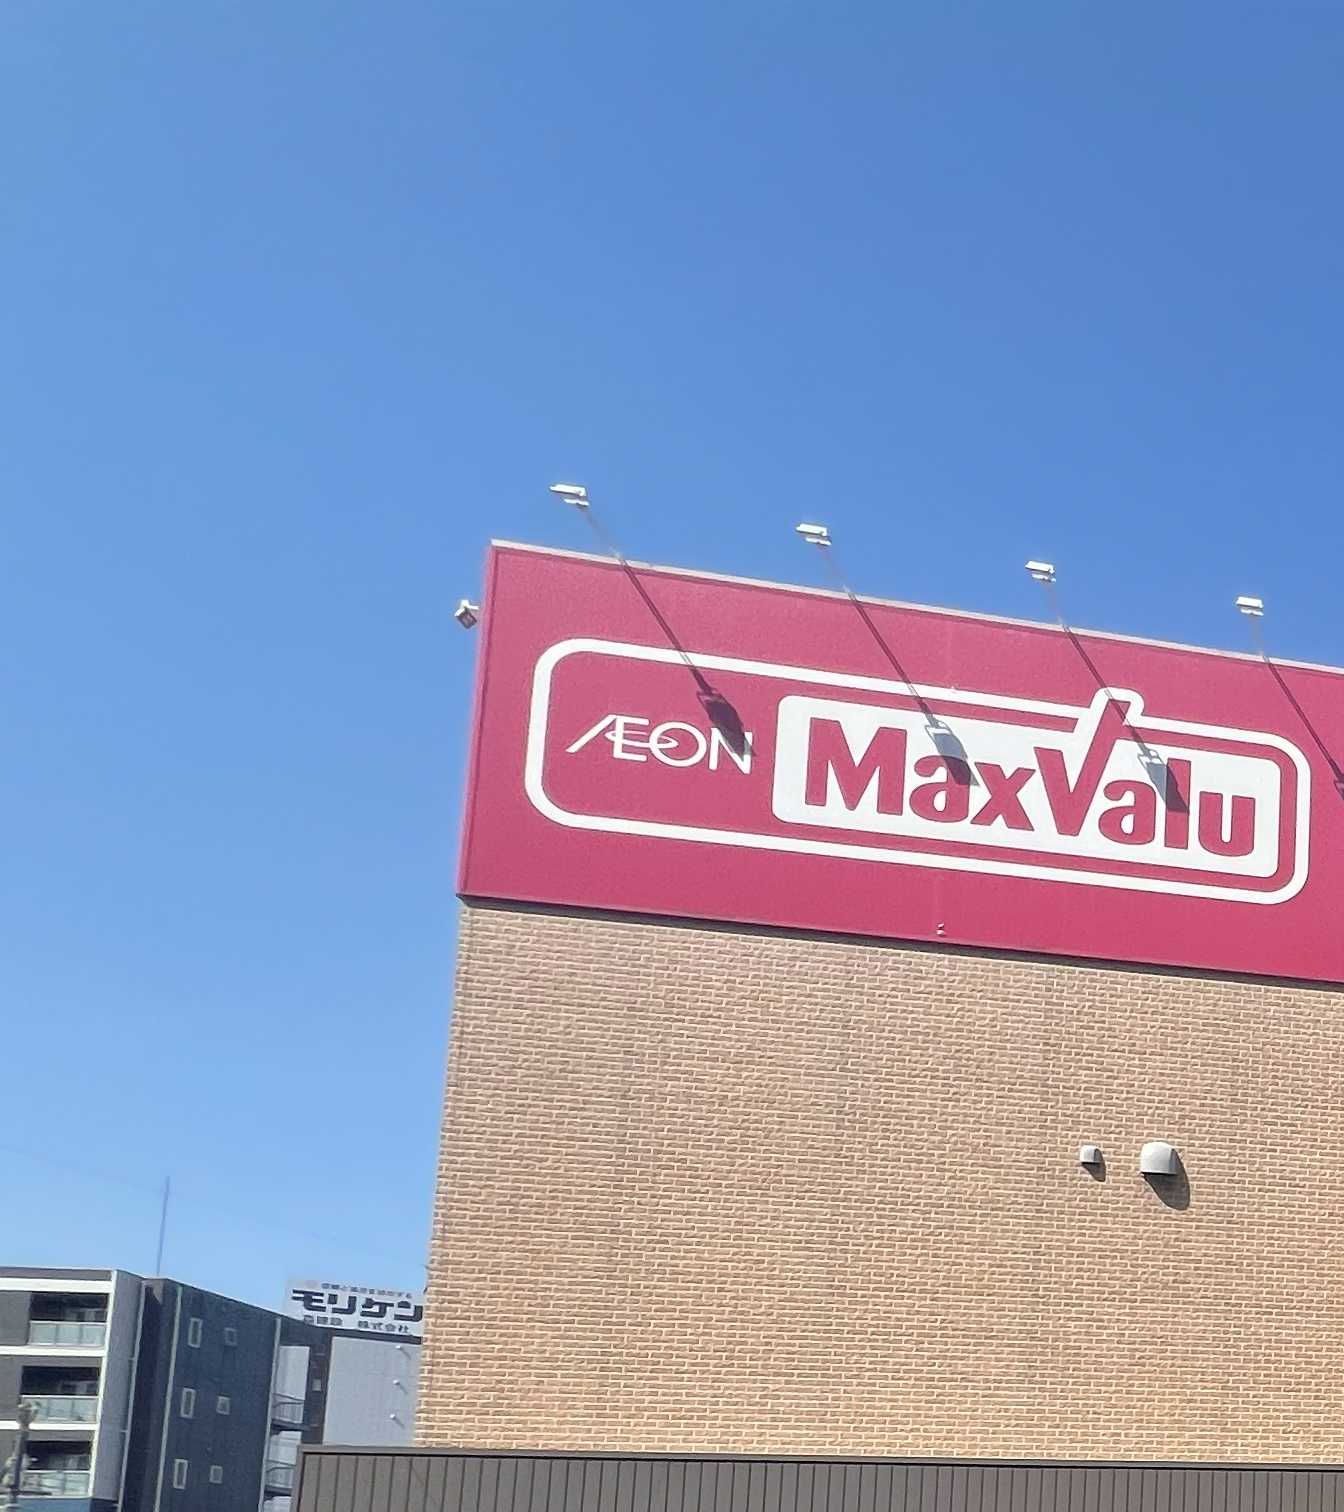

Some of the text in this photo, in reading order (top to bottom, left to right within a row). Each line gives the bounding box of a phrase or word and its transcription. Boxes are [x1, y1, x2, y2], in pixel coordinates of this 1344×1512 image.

[804, 698, 1257, 858] MaxValu
[291, 1289, 424, 1323] モリケン
